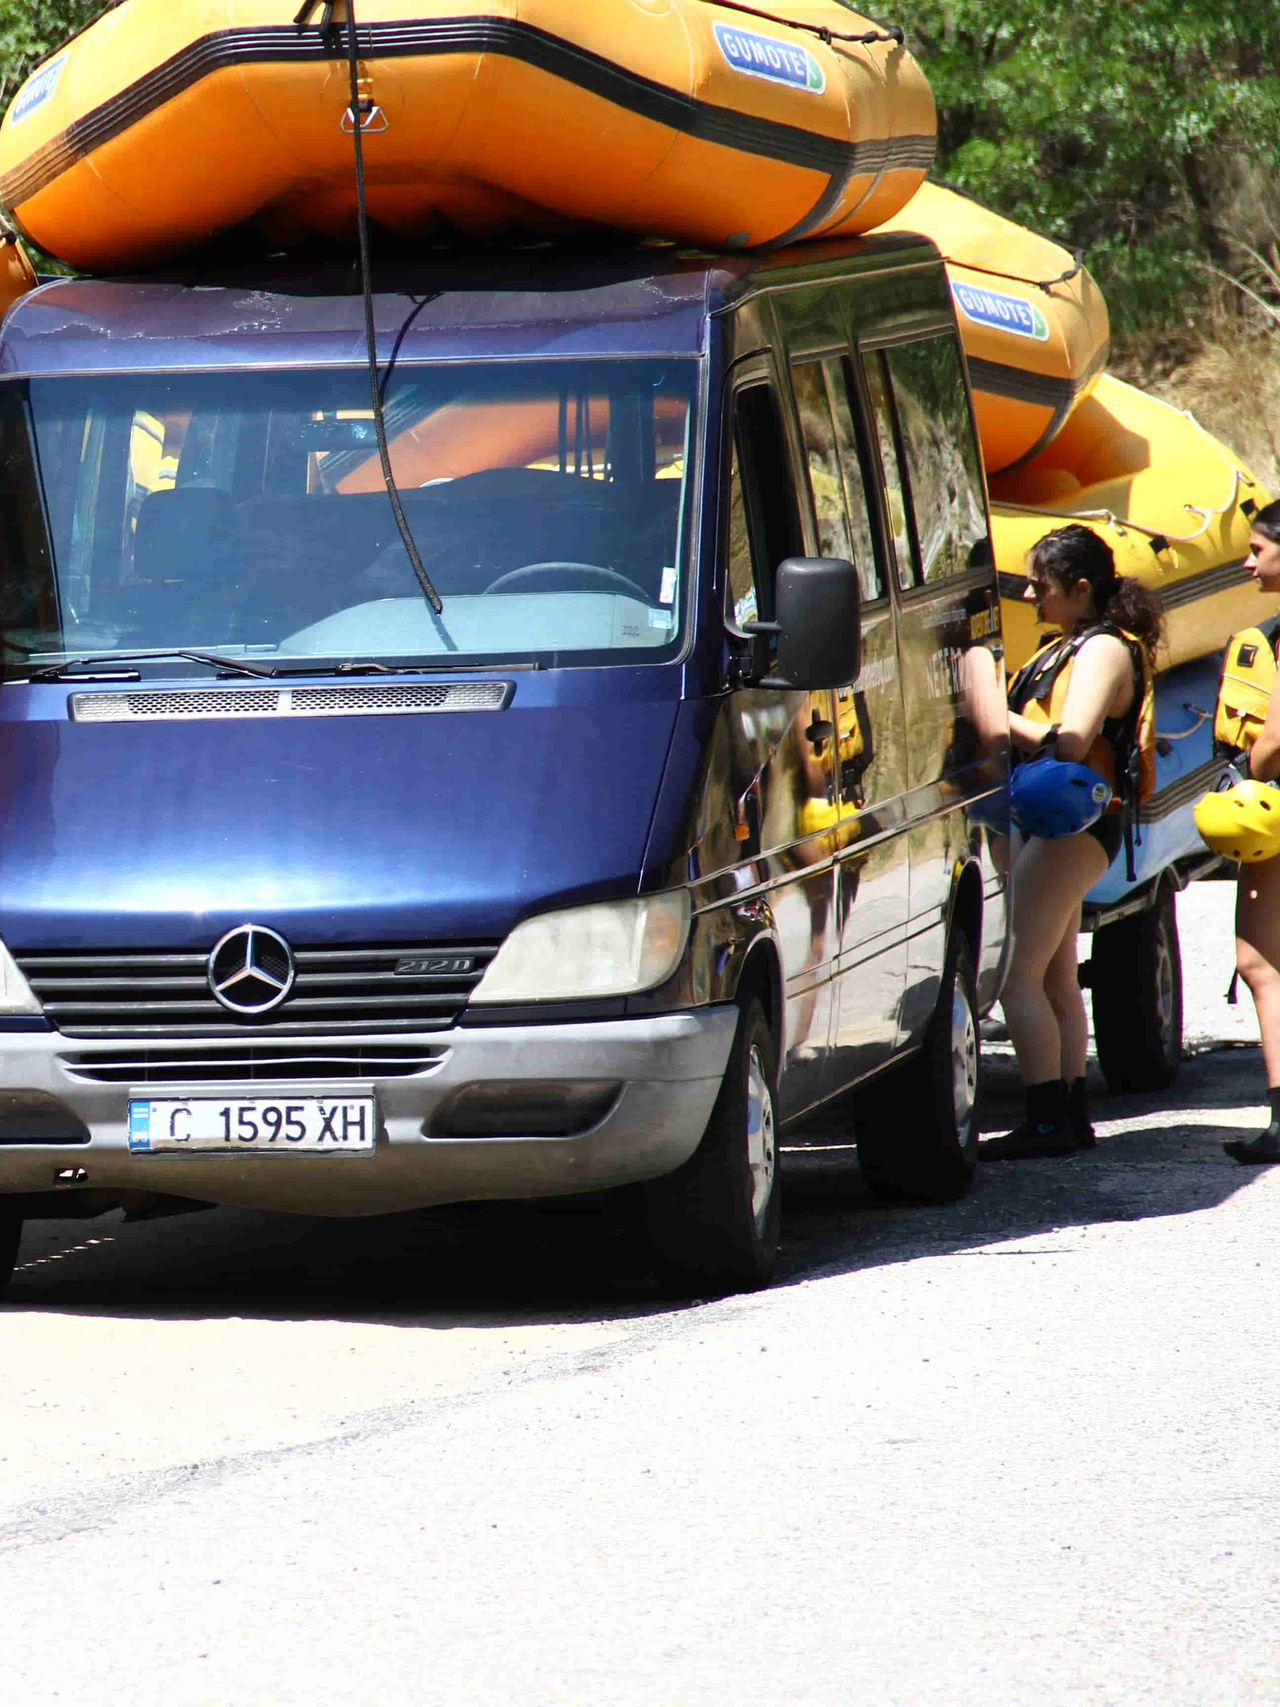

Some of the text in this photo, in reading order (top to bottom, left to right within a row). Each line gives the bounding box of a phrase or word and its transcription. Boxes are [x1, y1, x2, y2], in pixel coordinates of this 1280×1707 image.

[723, 32, 818, 80] GUMOTEX
[958, 288, 1044, 328] GUMOTEX
[170, 1104, 367, 1143] C 1595 XH
